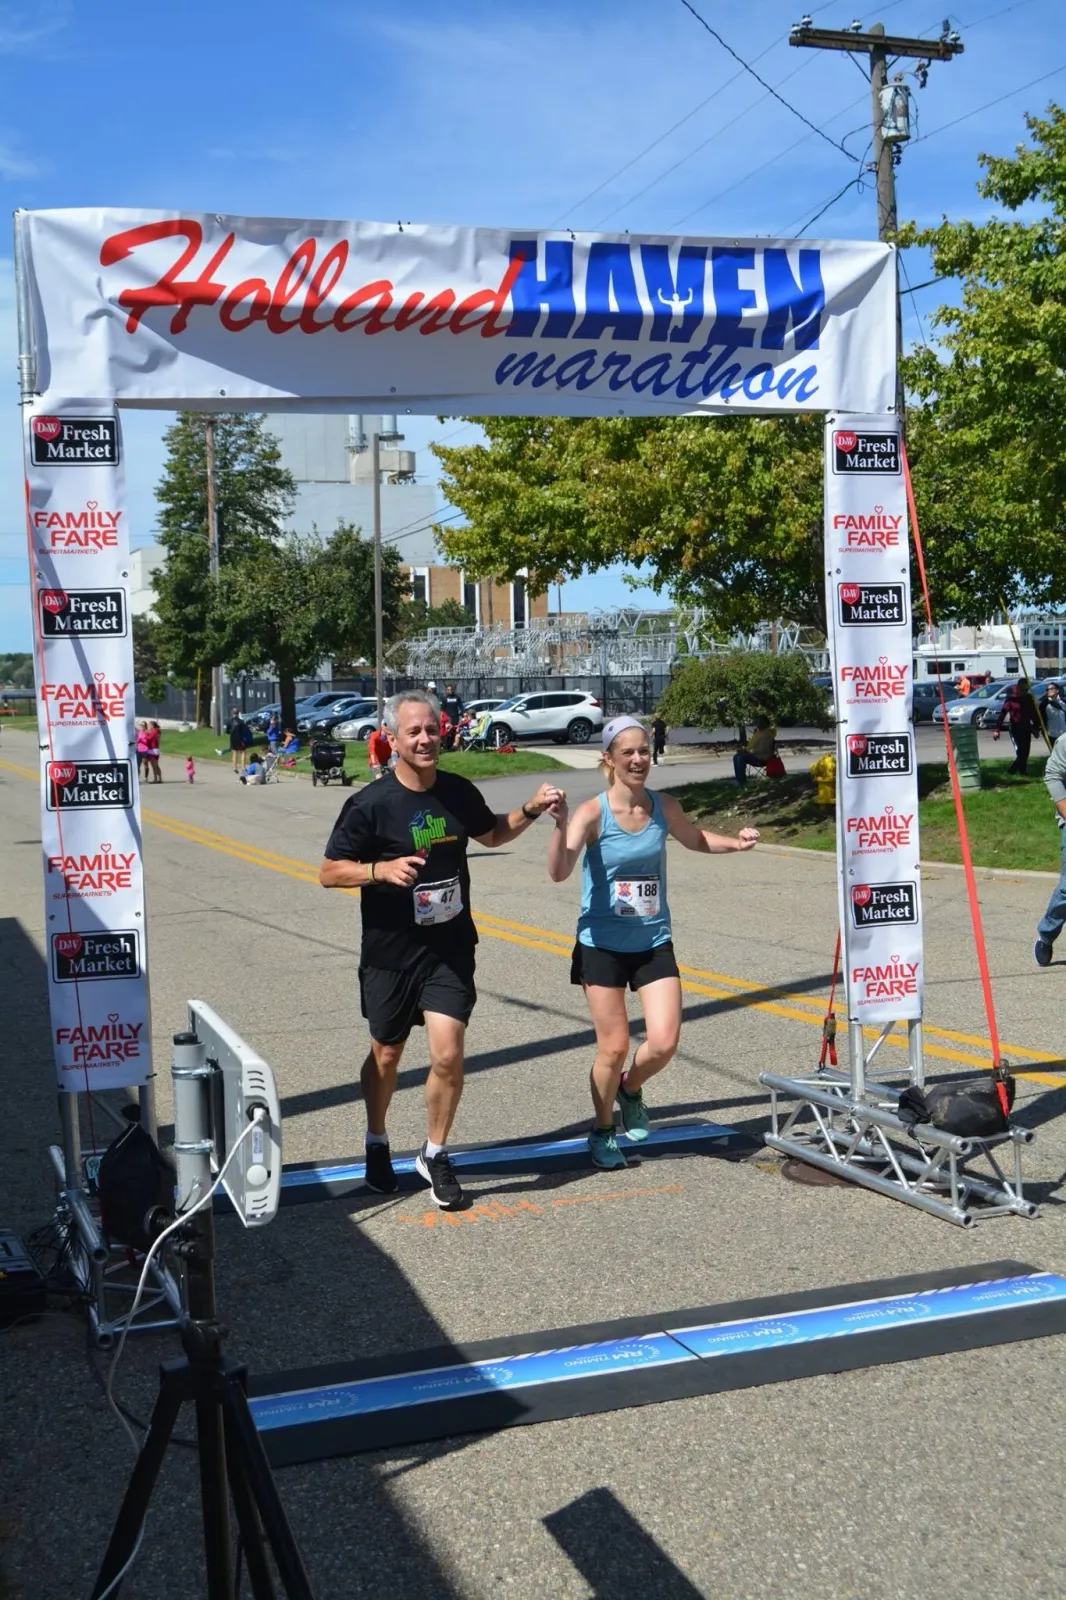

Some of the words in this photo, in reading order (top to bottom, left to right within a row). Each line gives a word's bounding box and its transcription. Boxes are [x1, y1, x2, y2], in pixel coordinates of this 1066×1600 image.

[100, 219, 527, 338] Holland
[505, 240, 825, 351] HAVEN
[494, 345, 819, 403] marathon
[62, 424, 110, 440] Fresh
[46, 442, 112, 458] Market
[857, 438, 896, 453] Fresh
[846, 454, 896, 468] Market
[33, 511, 123, 529] FAMILY
[833, 515, 903, 530] FAMILY
[50, 530, 119, 550] FARE
[847, 531, 900, 549] FARE
[69, 596, 118, 613] Fresh
[860, 589, 899, 604] Fresh
[850, 605, 900, 620] Market
[54, 614, 118, 631] Market
[841, 665, 909, 681] FAMILY
[40, 682, 129, 701] FAMILY
[855, 681, 905, 699] FARE
[58, 701, 125, 722] FARE
[867, 739, 905, 755] Fresh
[858, 755, 906, 770] Market
[76, 768, 125, 784] Fresh
[62, 785, 125, 802] Market
[847, 814, 914, 832] FAMILY
[858, 830, 911, 849] FARE
[47, 853, 136, 873] FAMILY
[65, 872, 132, 892] FARE
[637, 883, 657, 897] 188
[441, 888, 455, 904] 47
[871, 888, 910, 905] Fresh
[861, 904, 911, 921] Market
[83, 937, 132, 955] Fresh
[68, 956, 132, 974] Market
[852, 962, 920, 983] FAMILY
[866, 978, 917, 998] FARE
[56, 1022, 144, 1045] FAMILY
[73, 1040, 140, 1062] FARE
[707, 1333, 751, 1343] TIMING
[753, 1327, 783, 1337] RM
[564, 1355, 610, 1367] TIMING
[612, 1350, 644, 1360] RM
